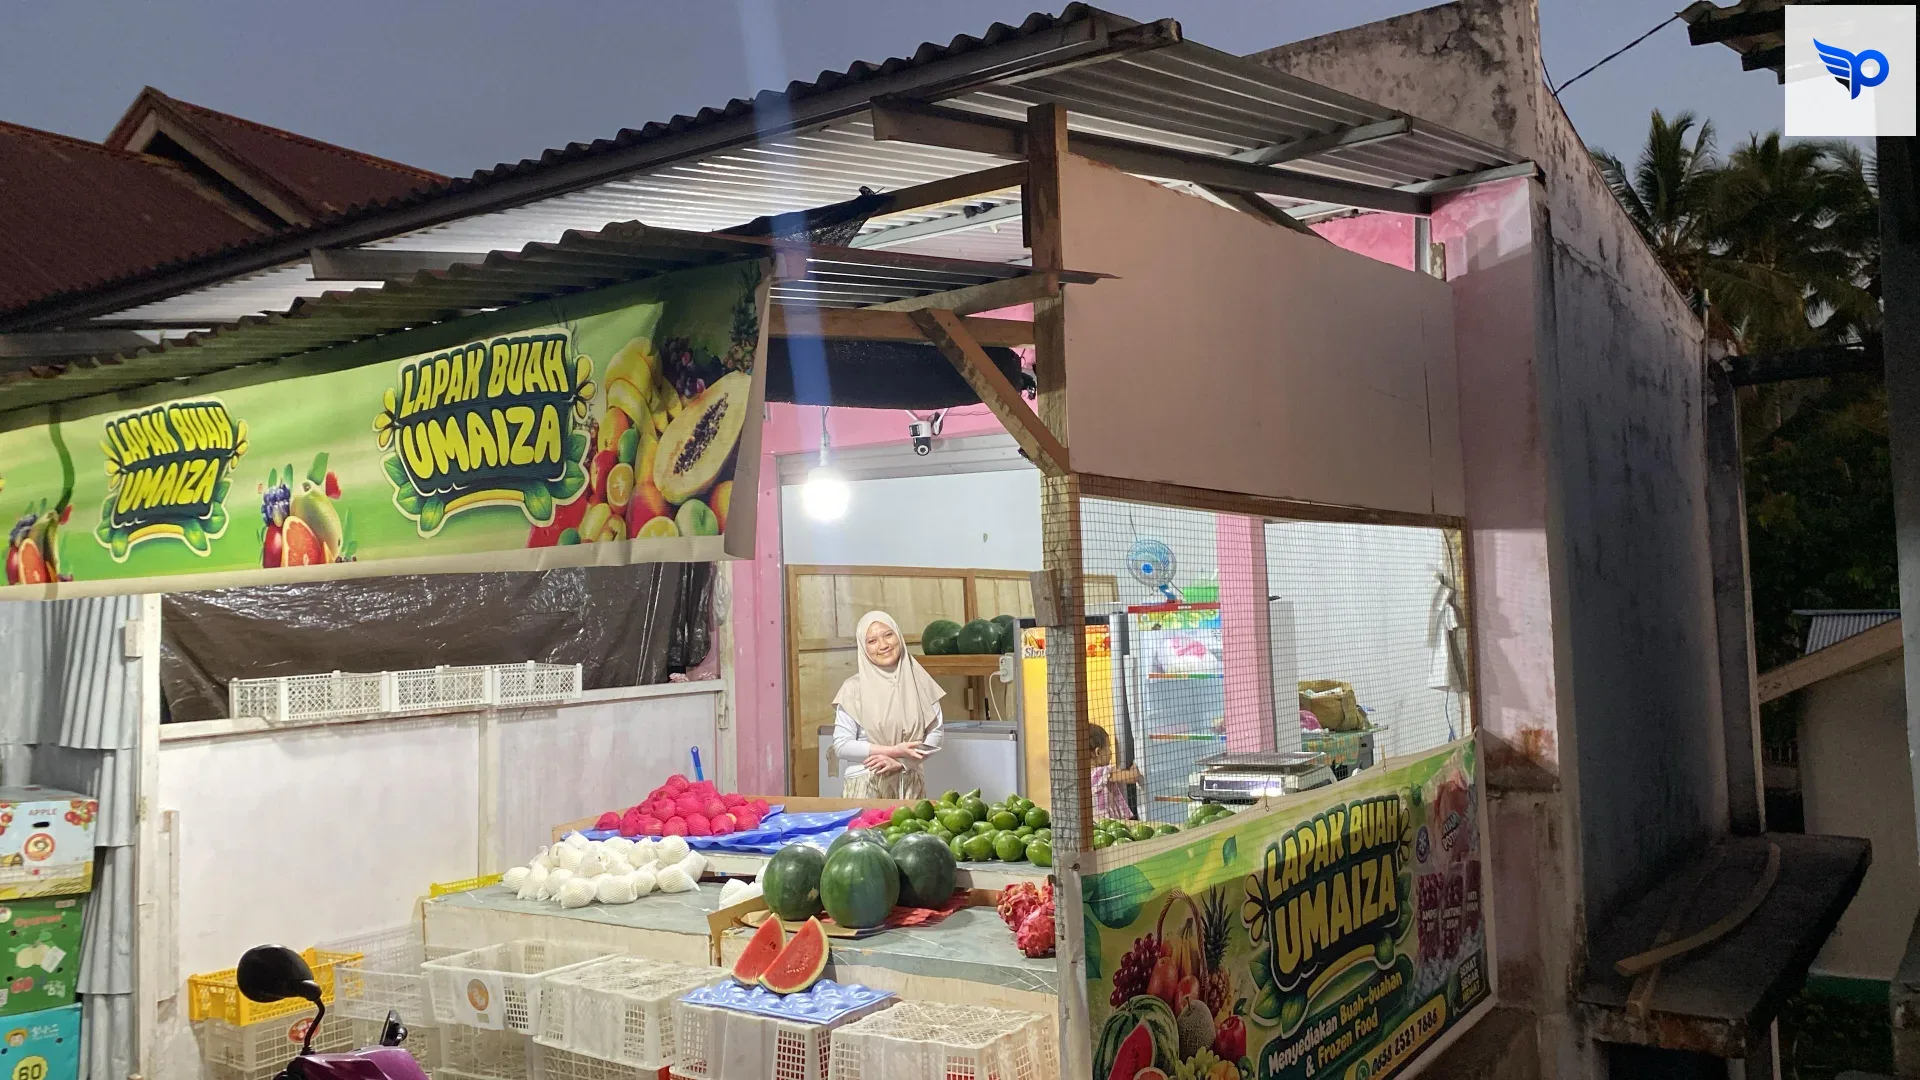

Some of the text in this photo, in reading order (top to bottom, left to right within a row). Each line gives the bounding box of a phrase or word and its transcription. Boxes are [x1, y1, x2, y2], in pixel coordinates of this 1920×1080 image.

[400, 339, 569, 419] LAPAK BUAH
[107, 405, 234, 463] LAPAK BUAH
[401, 403, 562, 479] UMAIZA
[117, 457, 221, 514] UMAIZA
[28, 808, 57, 816] APPLE
[1266, 799, 1398, 901] LAPAK BUAH
[1274, 853, 1397, 973] UMAIZA
[1461, 968, 1479, 990] SEGAR
[1268, 971, 1403, 1077] Menyediakan Buah-buahan
[1306, 1007, 1379, 1077] & Frozen Food
[1394, 1025, 1415, 1056] 2521
[18, 1063, 42, 1080] 60
